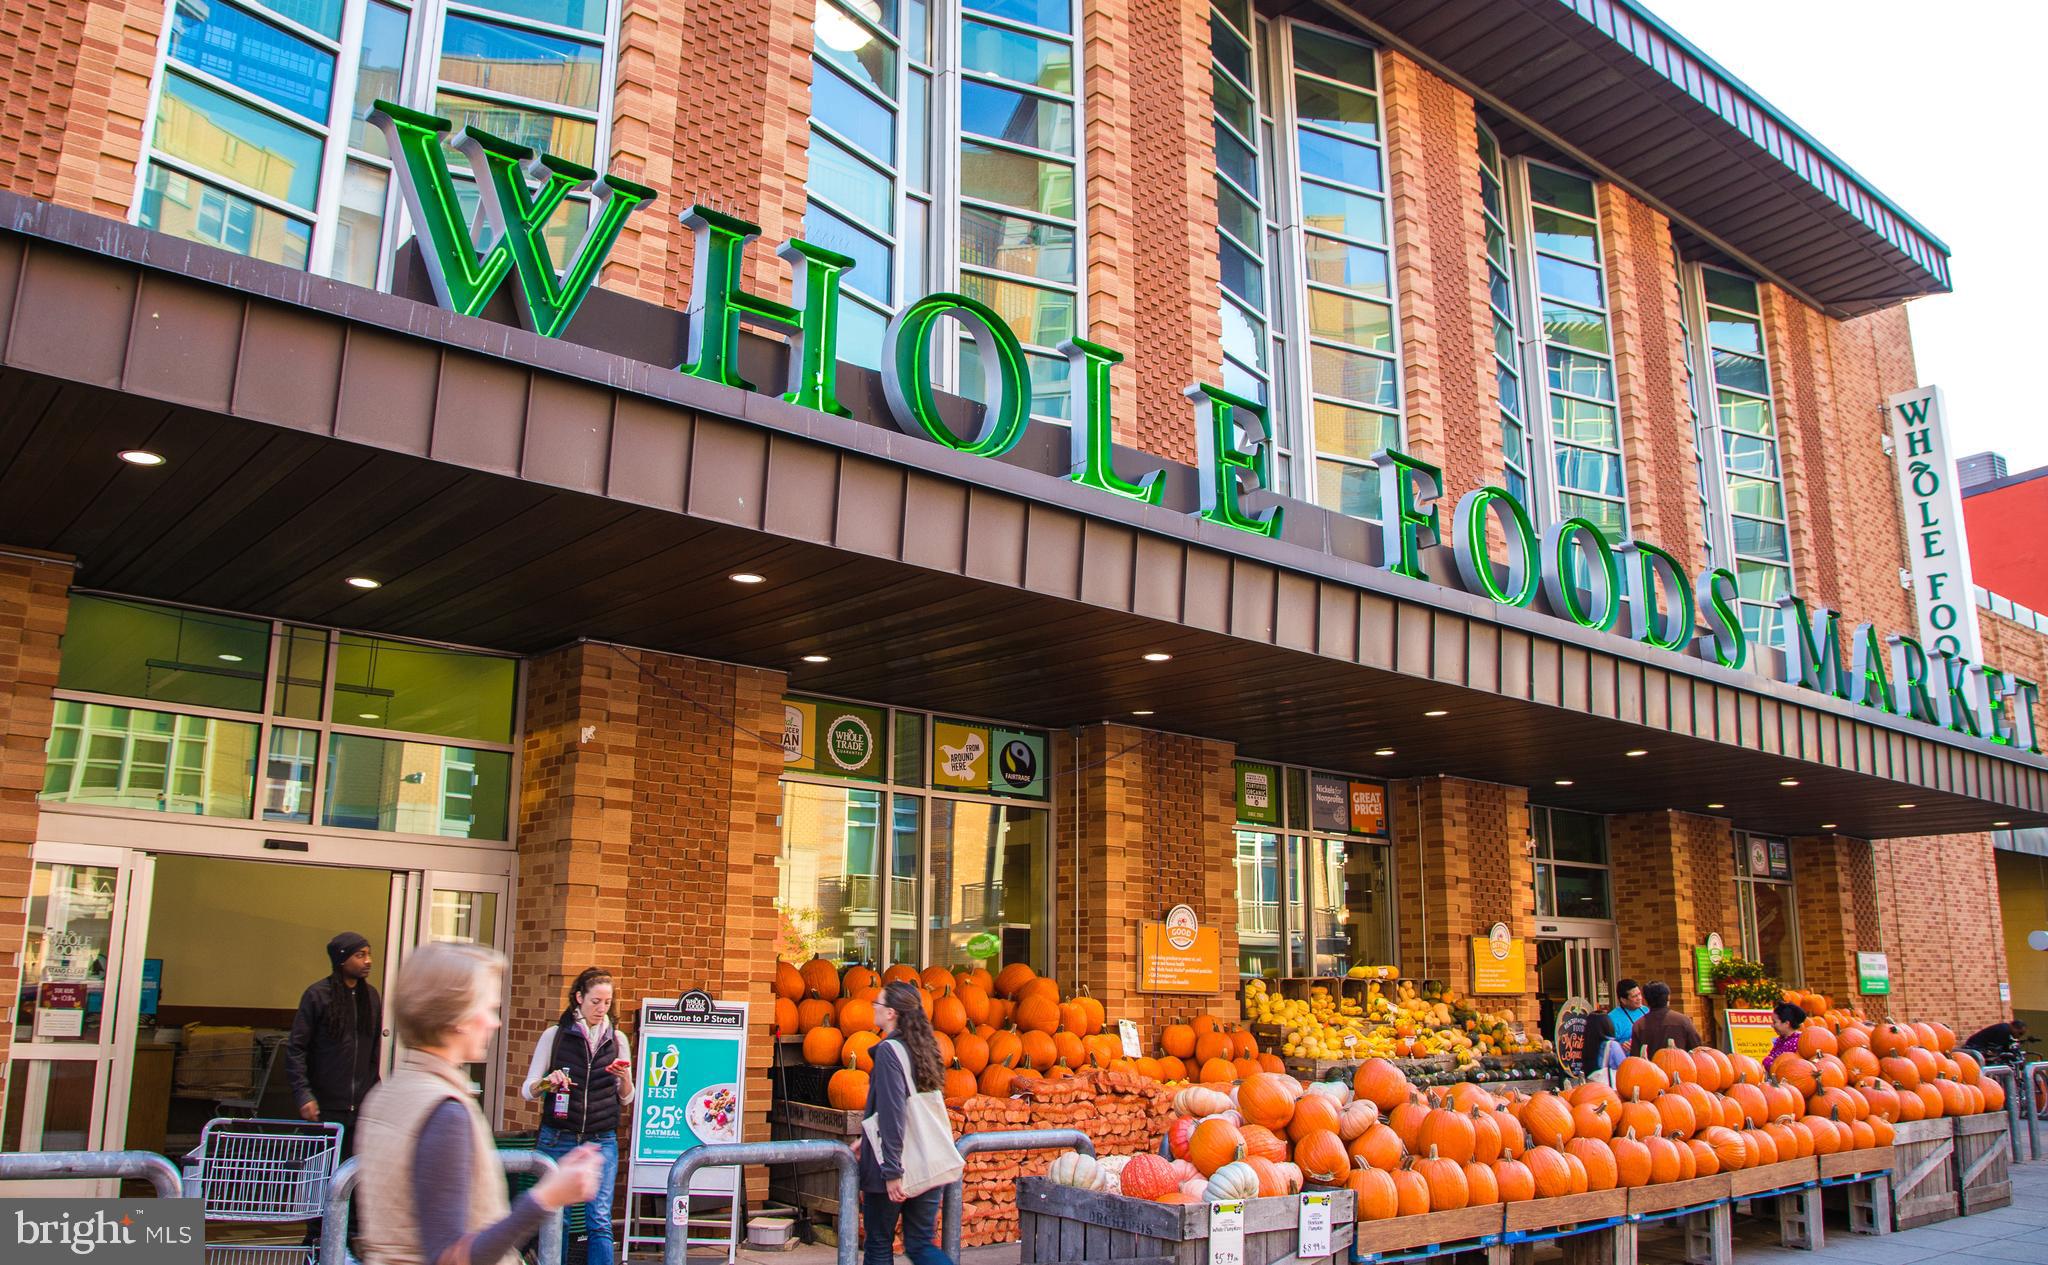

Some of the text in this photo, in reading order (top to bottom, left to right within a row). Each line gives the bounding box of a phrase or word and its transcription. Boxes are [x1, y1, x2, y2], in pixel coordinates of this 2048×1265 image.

[365, 100, 2043, 755] WHOLE FOODS MARKET
[1896, 397, 1961, 659] WHOLE FOO
[835, 729, 864, 743] WHOLE
[836, 739, 864, 751] TRADE
[966, 744, 980, 753] FROM
[950, 752, 974, 764] AROUND
[951, 762, 967, 772] HERE
[1005, 772, 1031, 783] FAIRTRADE
[1352, 792, 1381, 804] GREAT
[1354, 803, 1382, 815] PRICE!
[1172, 928, 1192, 937] GOOD
[654, 1012, 736, 1024] Welcome to P Street
[1731, 1015, 1747, 1023] BIG
[648, 1087, 677, 1099] FEST
[645, 1129, 681, 1137] OATMEAL
